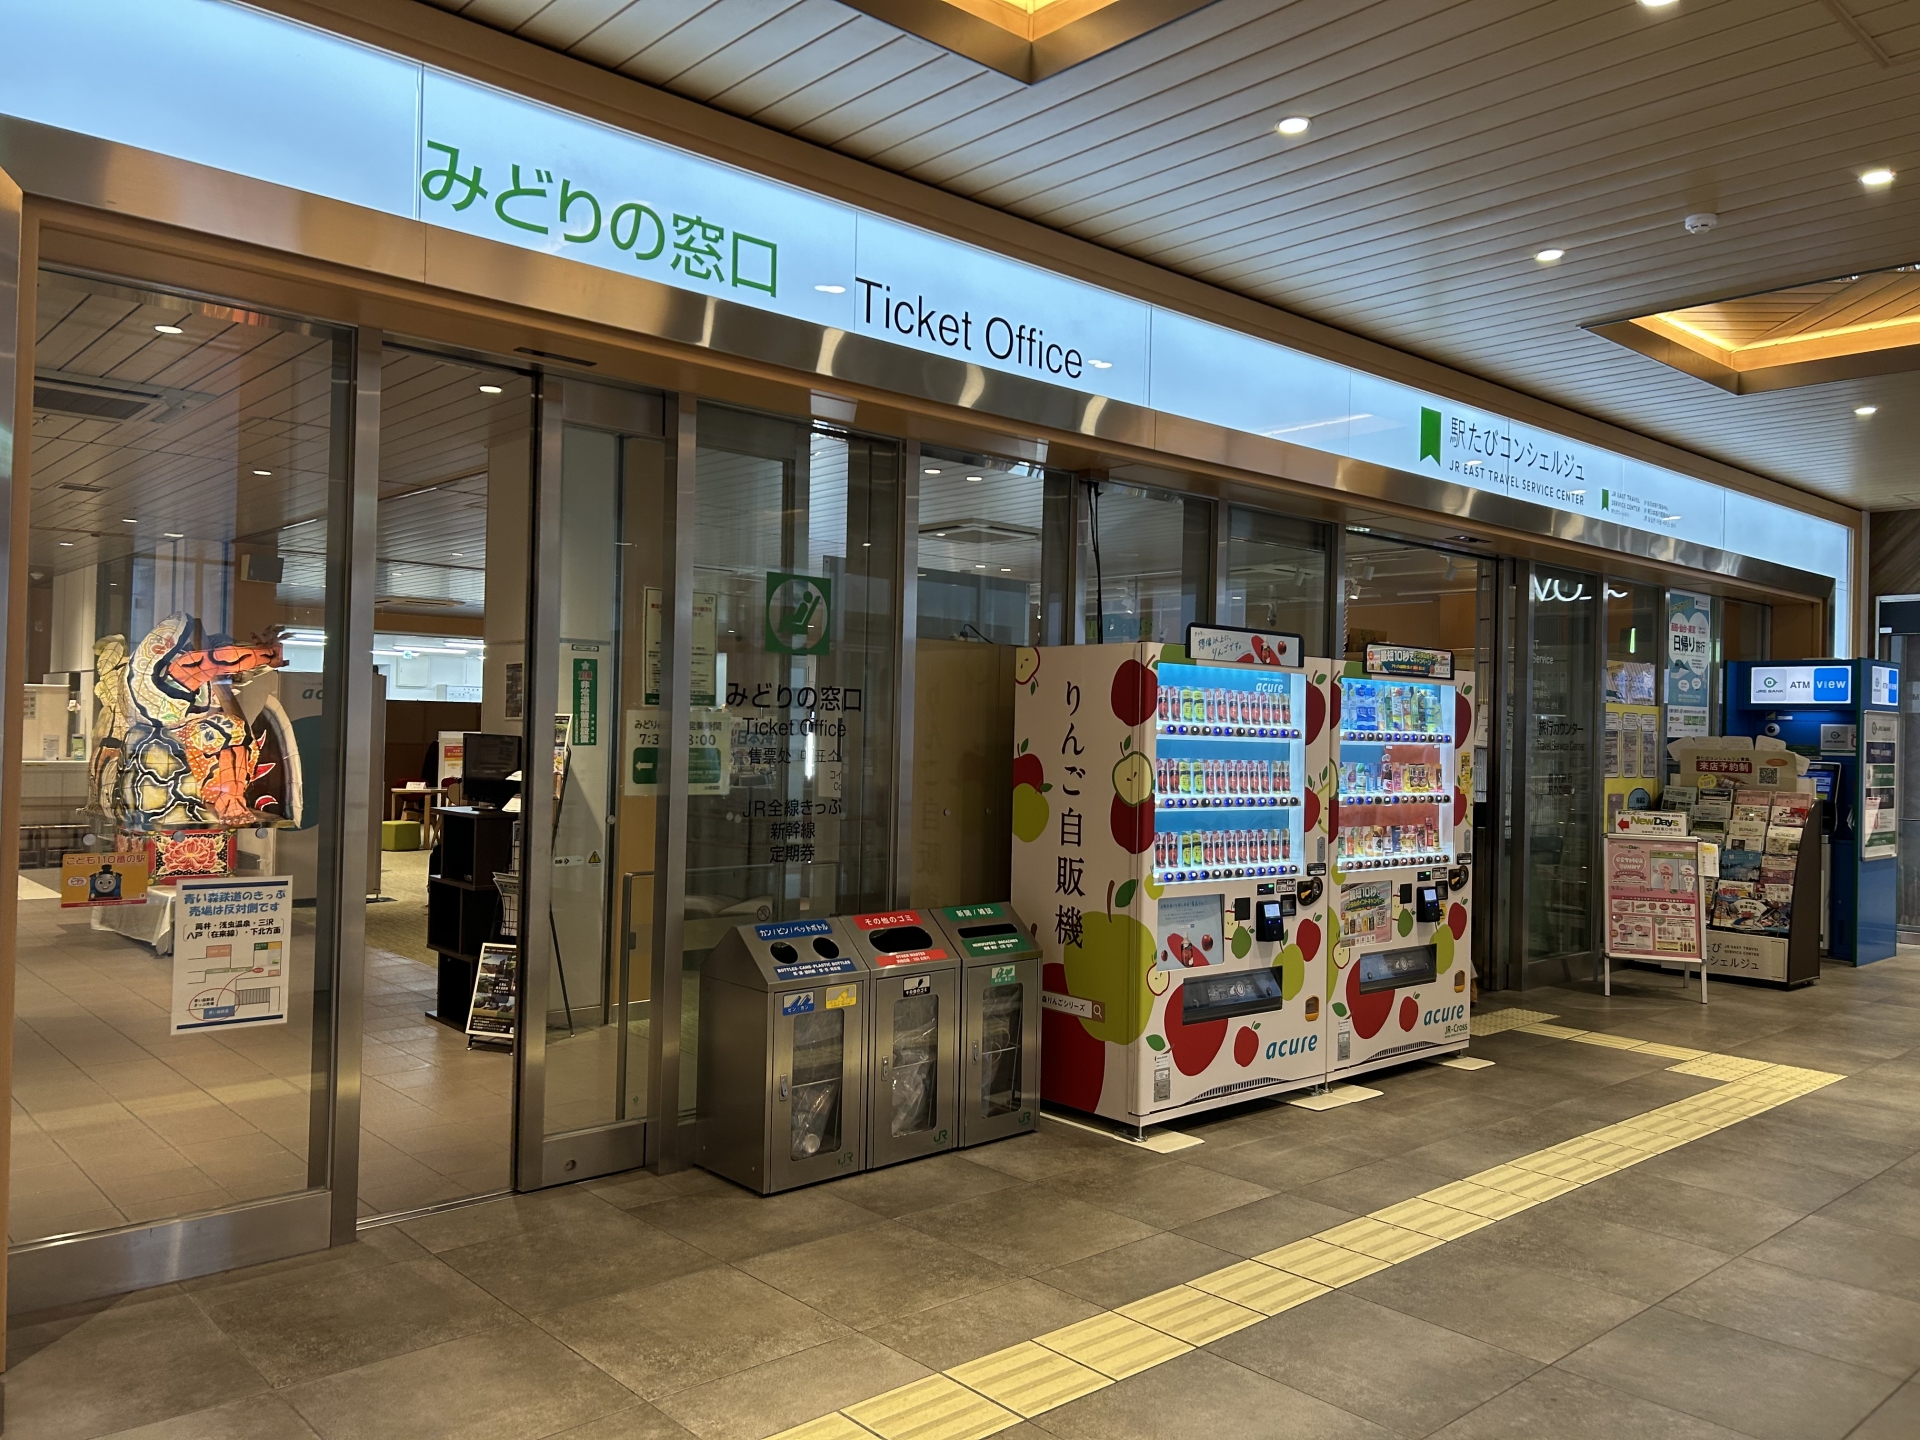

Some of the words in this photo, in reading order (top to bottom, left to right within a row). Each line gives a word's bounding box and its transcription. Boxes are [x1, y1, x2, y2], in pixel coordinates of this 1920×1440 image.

[421, 140, 778, 298] みどりの窓口
[855, 276, 972, 351] Ticket
[985, 316, 1083, 379] Office
[1450, 417, 1585, 481] 駅たびコンシェルジュ
[1449, 459, 1460, 473] JR
[1463, 463, 1485, 479] EAST
[1488, 470, 1519, 488] TRAVEL
[1521, 479, 1554, 498] SERVICE
[1556, 489, 1585, 506] CENTER
[1256, 682, 1284, 693] acure
[1790, 681, 1811, 689] ATM
[726, 683, 862, 712] みどりの窓口
[742, 717, 794, 737] Ticket
[800, 718, 847, 737] Office
[1538, 720, 1584, 736] 旅行カウンター
[1700, 761, 1749, 772] 来店予約制
[742, 798, 842, 818] JR全線きっぷ
[1055, 681, 1086, 949] りんご自販機
[1630, 816, 1679, 827] NewDays
[770, 821, 816, 840] 新幹線
[66, 854, 146, 866] こども110番の駅
[769, 844, 815, 863] 定期券
[184, 889, 286, 904] 青い森鉄道のきっぷ
[188, 902, 280, 917] 売場は反対側です
[864, 914, 914, 926] その他のゴミ
[1424, 1004, 1464, 1026] acure
[1444, 1023, 1468, 1035] JR-Cross
[1265, 1034, 1318, 1060] acure
[1018, 1111, 1031, 1124] JR
[933, 1129, 948, 1143] JR
[837, 1151, 853, 1165] JR
